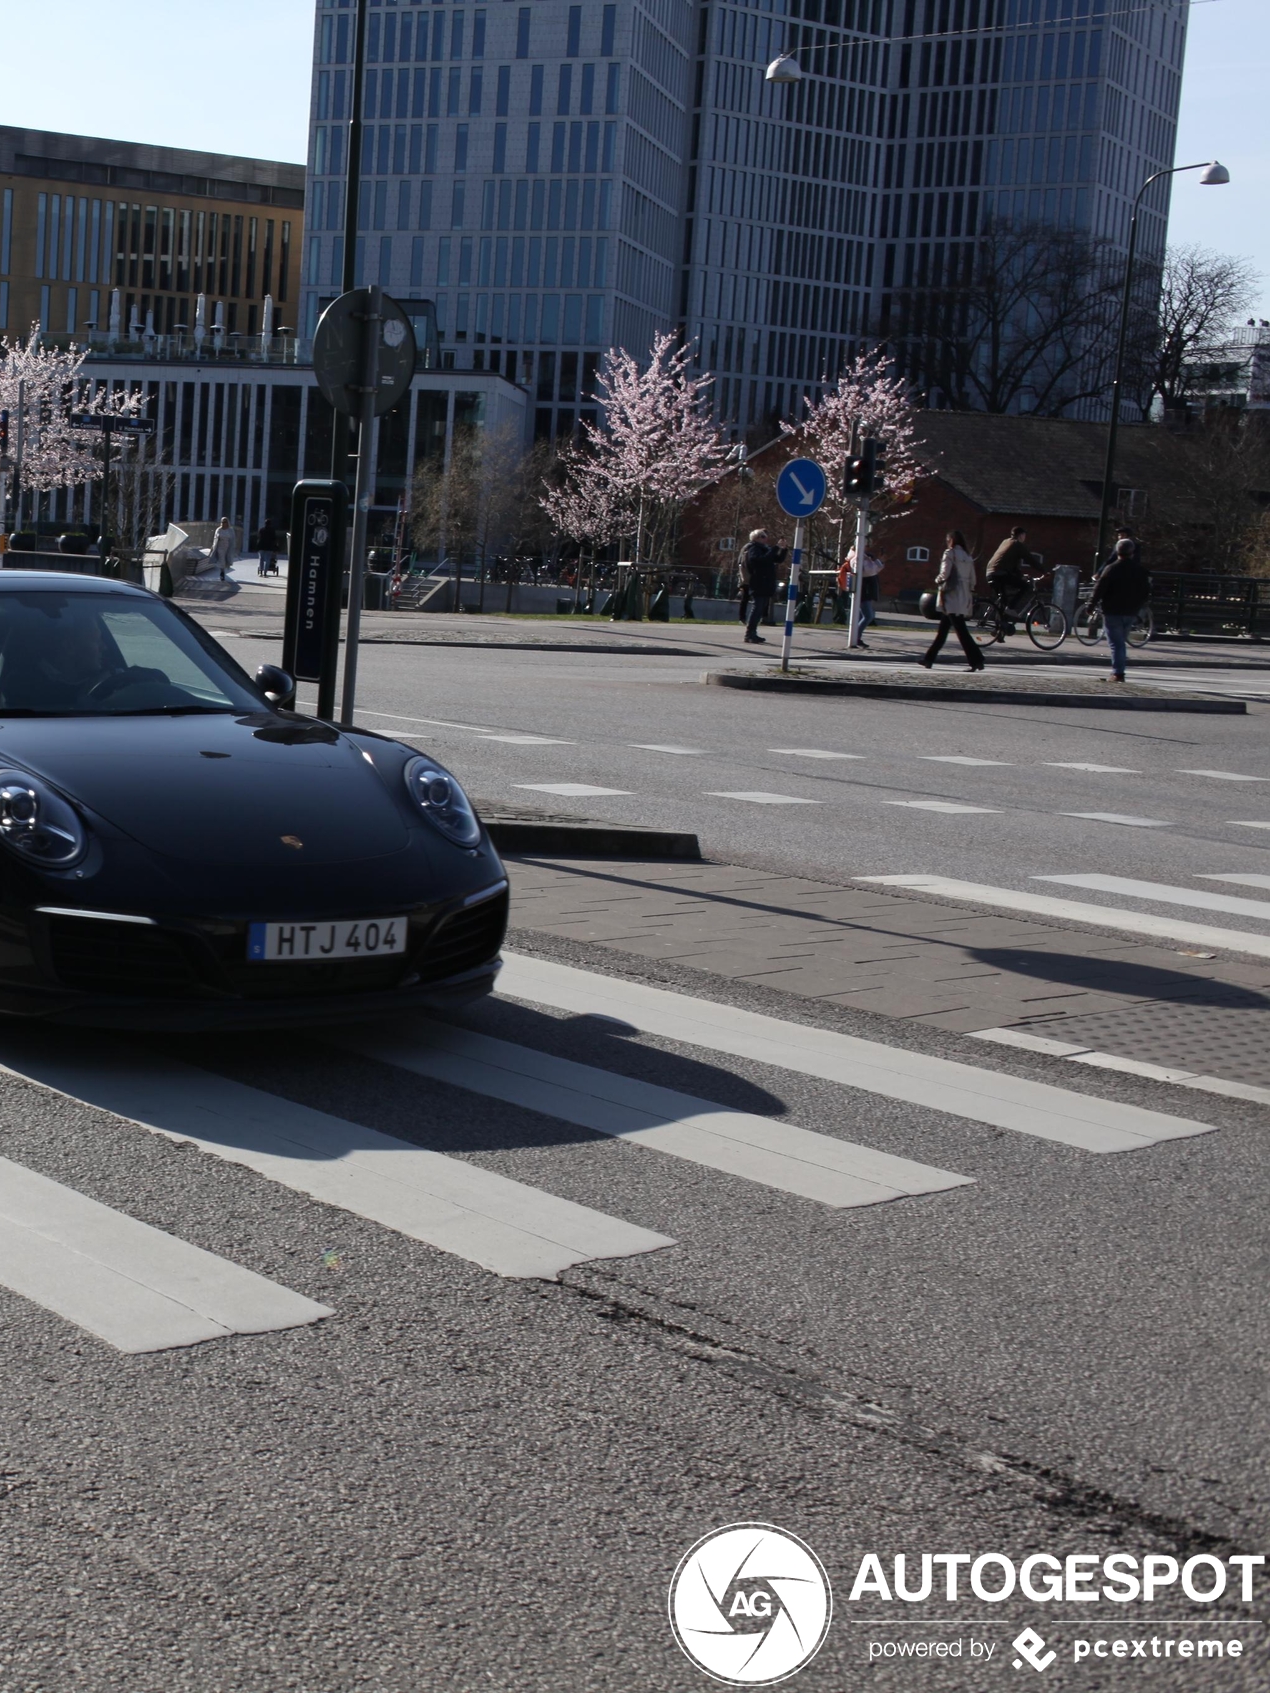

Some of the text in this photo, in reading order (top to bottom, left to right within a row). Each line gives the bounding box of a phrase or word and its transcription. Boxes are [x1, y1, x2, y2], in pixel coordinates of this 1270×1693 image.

[305, 555, 321, 629] Hamnen
[253, 945, 261, 954] S
[277, 921, 397, 956] HTJ 404
